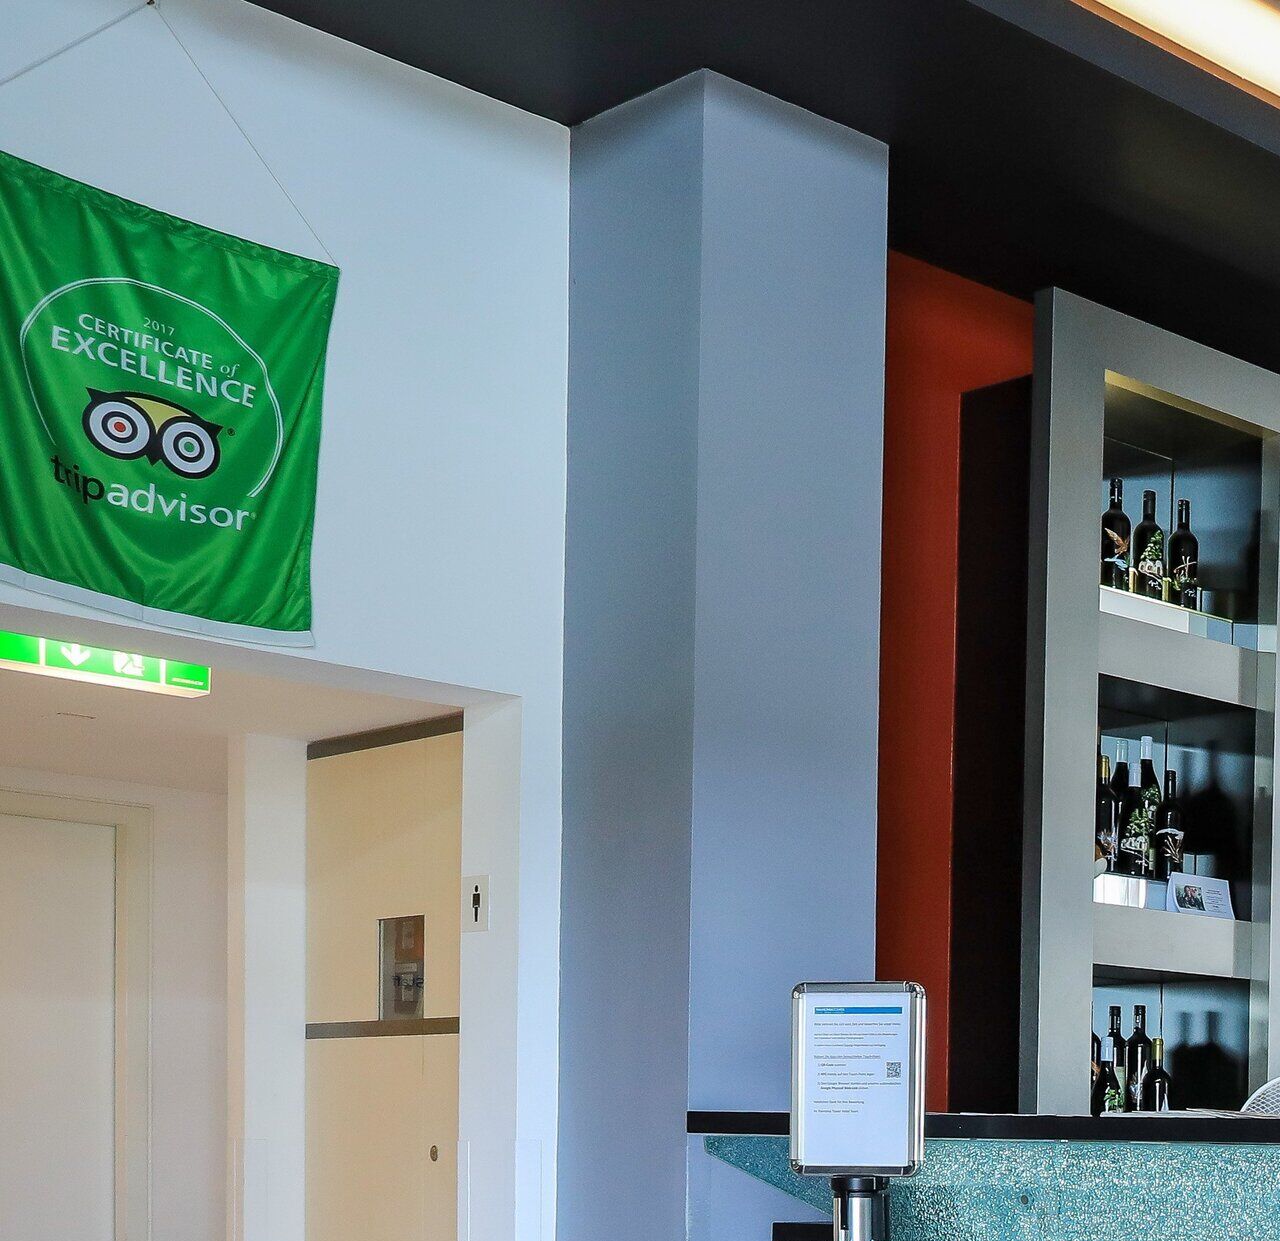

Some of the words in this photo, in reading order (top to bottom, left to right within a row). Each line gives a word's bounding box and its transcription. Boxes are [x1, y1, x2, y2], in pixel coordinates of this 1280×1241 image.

[77, 313, 213, 371] CERTIFICATE
[220, 363, 240, 378] of
[142, 317, 175, 336] 2017
[51, 325, 257, 408] EXCELLENCE
[50, 454, 250, 531] tripadvisor
